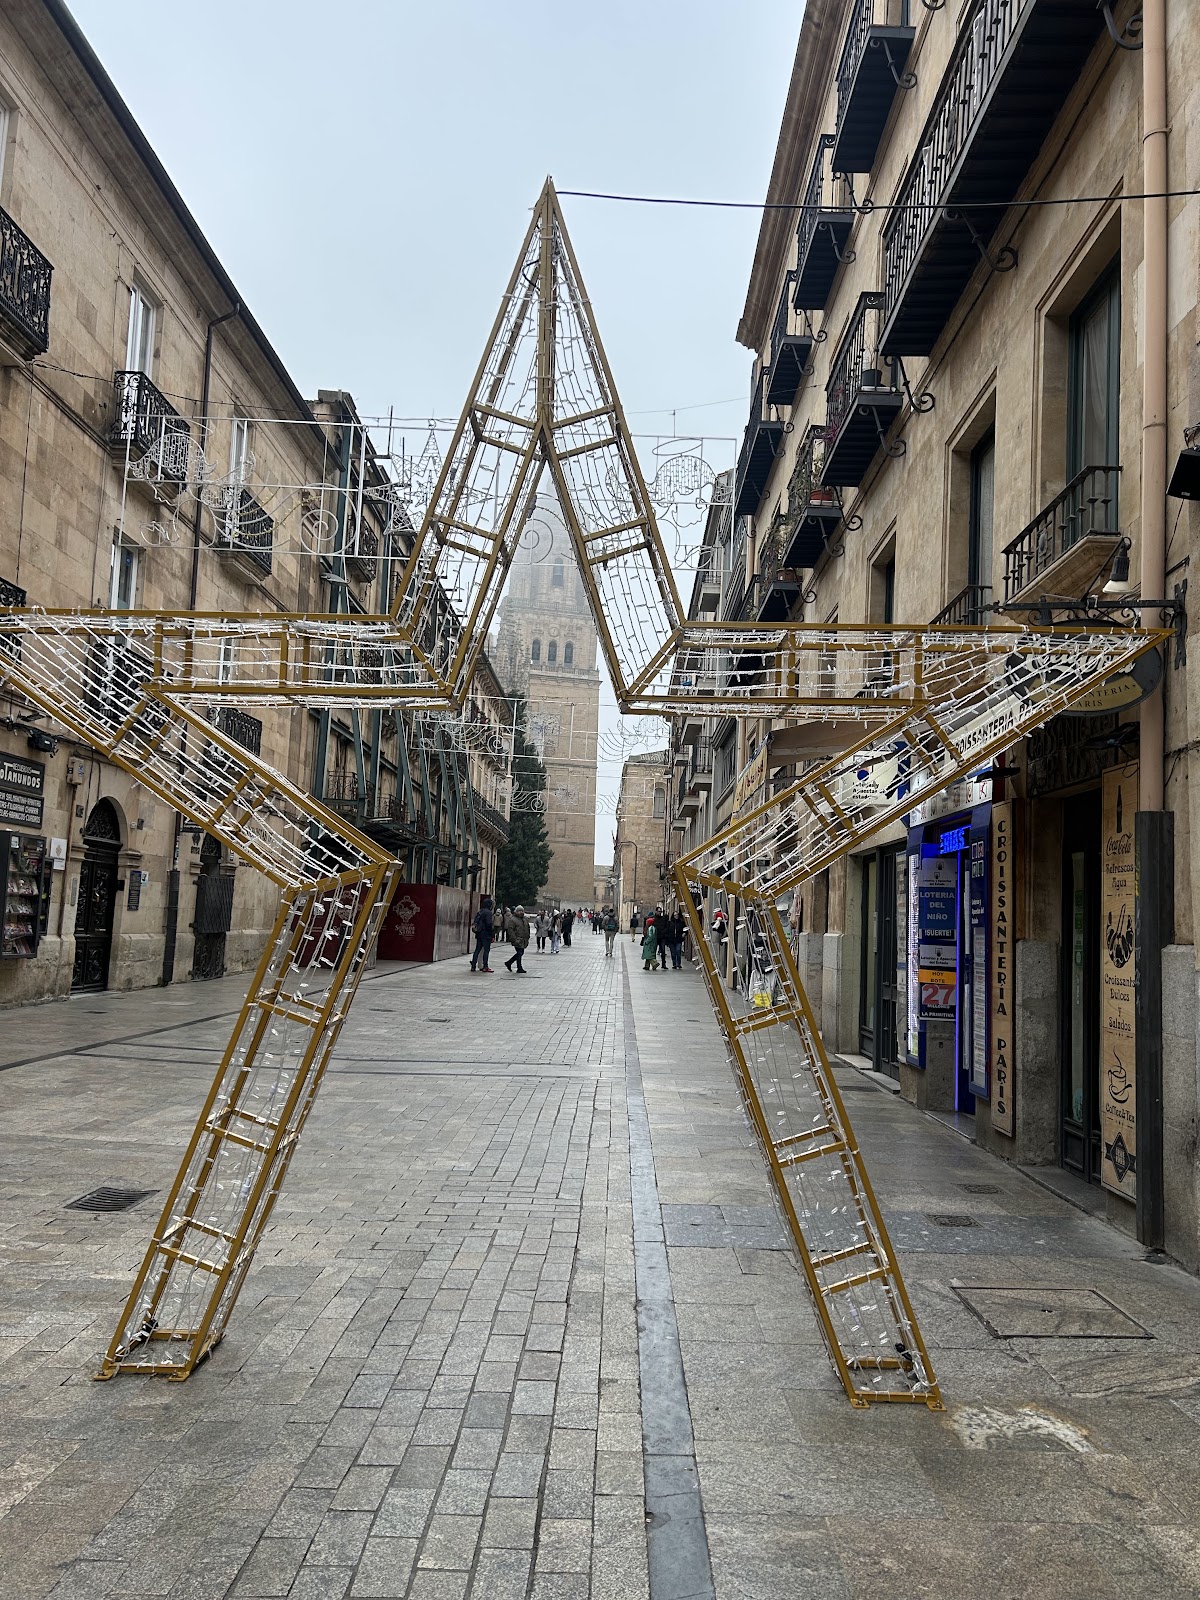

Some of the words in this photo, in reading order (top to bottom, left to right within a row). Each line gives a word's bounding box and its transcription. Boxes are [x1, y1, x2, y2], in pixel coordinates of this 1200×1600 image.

[1070, 700, 1103, 708] ARIS
[920, 891, 955, 899] LOTERIA
[926, 912, 948, 921] NIÑO
[922, 984, 955, 1005] 27
